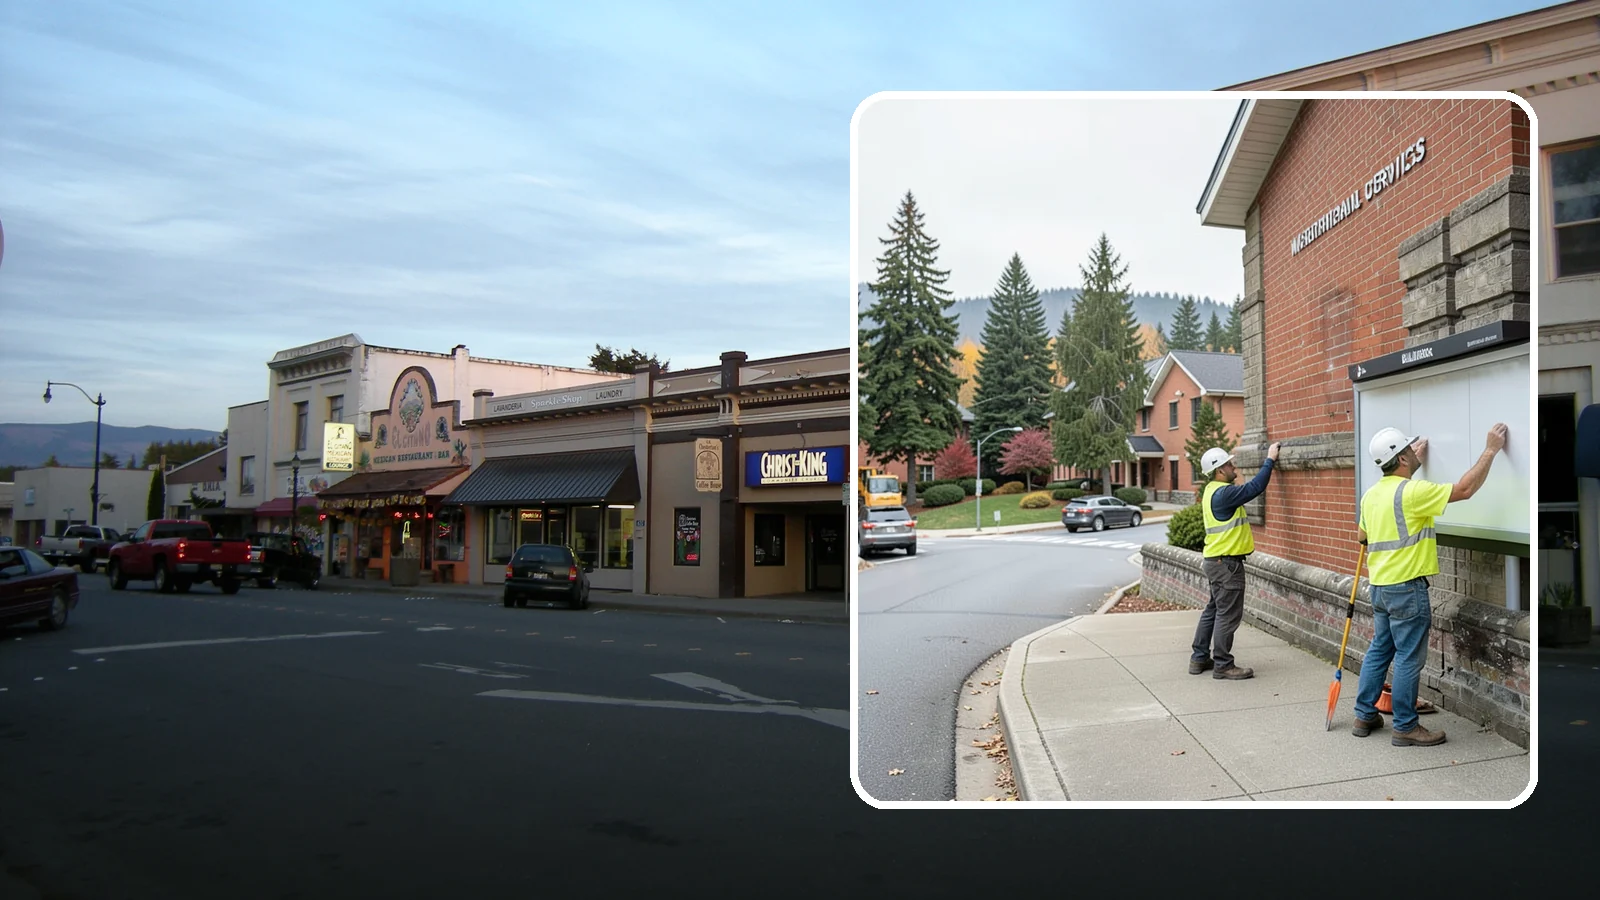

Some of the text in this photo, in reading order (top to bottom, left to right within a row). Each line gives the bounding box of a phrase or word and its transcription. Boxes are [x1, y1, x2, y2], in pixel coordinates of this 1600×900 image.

[595, 389, 624, 400] LAUNDRY
[493, 402, 523, 413] LAVANDERIA
[531, 395, 582, 409] Sparkle Shop
[374, 455, 396, 464] MEXICAN
[397, 451, 433, 462] RESTAURANT
[438, 450, 450, 459] BAR
